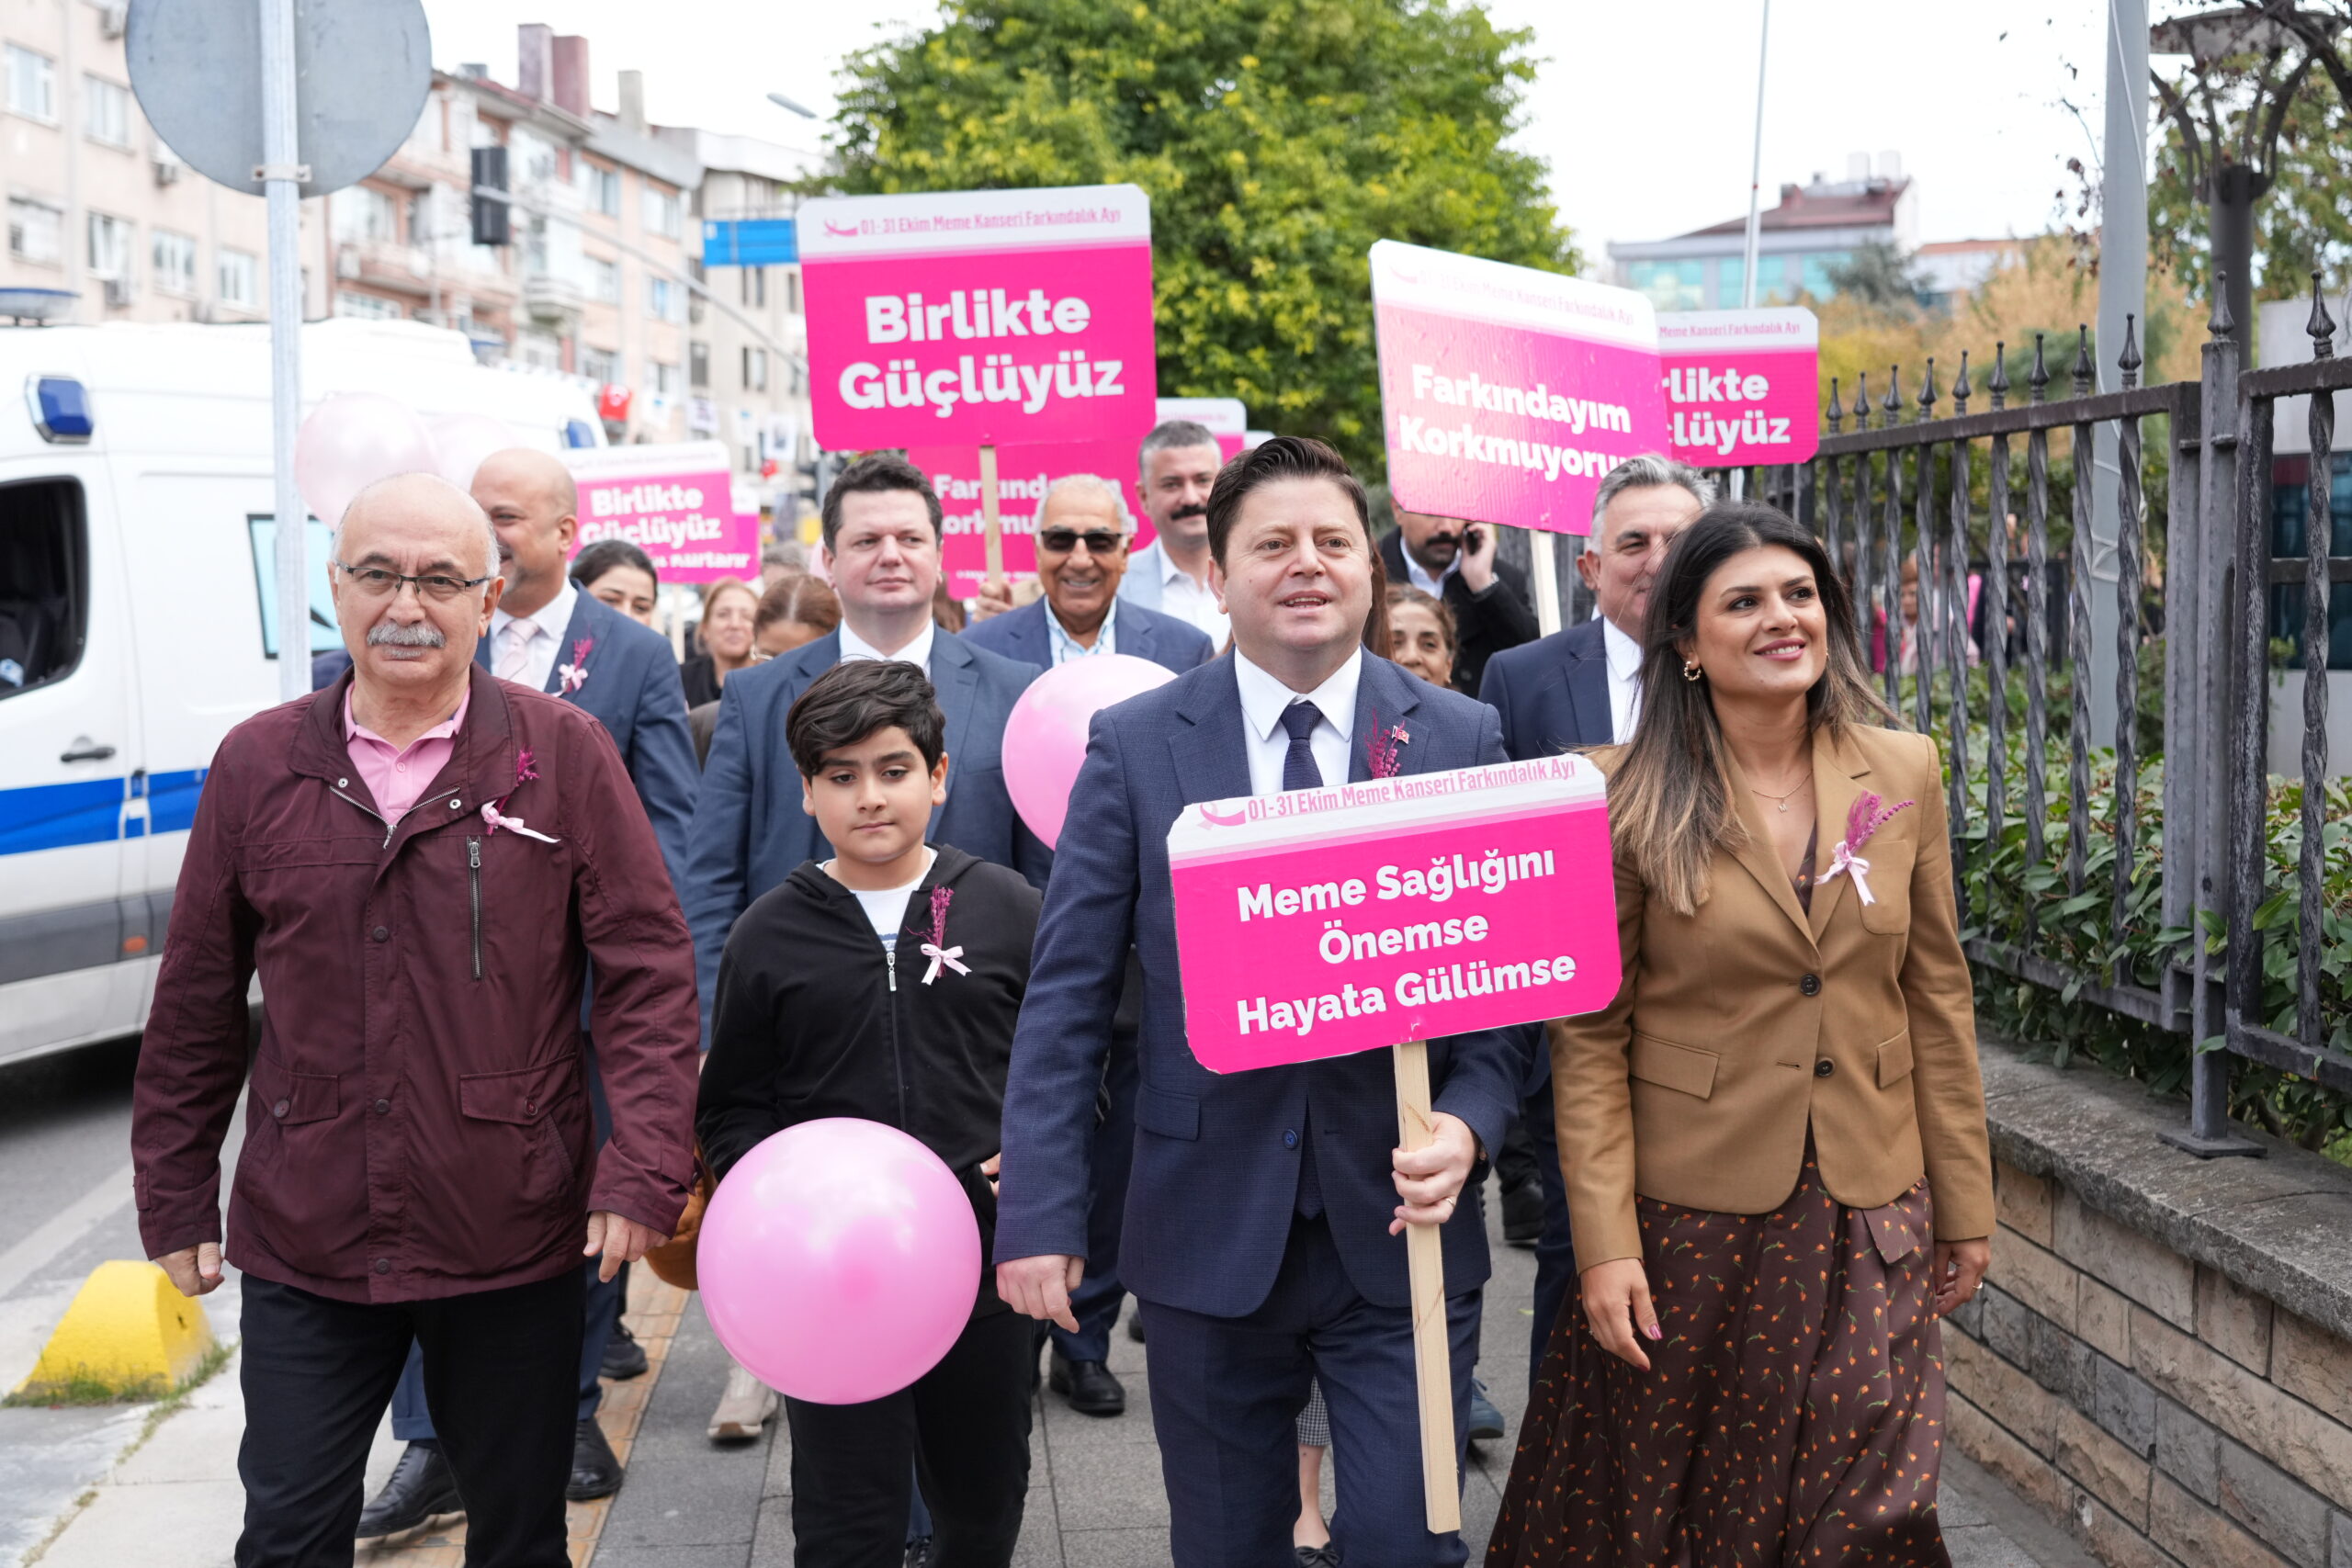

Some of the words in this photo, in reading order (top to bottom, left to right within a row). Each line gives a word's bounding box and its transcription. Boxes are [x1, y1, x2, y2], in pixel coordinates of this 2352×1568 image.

[899, 217, 930, 233] Ekim
[933, 215, 971, 231] Meme
[974, 212, 1022, 229] Kanseri
[1024, 209, 1097, 226] Farkındalık
[1101, 207, 1121, 224] Ayı
[865, 288, 1091, 344] Birlikte
[1516, 288, 1557, 310] Kanseri
[1659, 325, 1688, 338] Meme
[1690, 324, 1726, 337] Kanseri
[1728, 323, 1782, 336] Farkındalık
[1785, 322, 1801, 334] Ayı
[839, 350, 1125, 418] Güçlüyüz
[1412, 365, 1631, 435] Farkındayım
[1398, 415, 1626, 481] Korkmuyoru
[1667, 410, 1791, 455] lüyüz
[590, 484, 704, 517] Birlikte
[1248, 795, 1294, 820] 01-31
[1297, 791, 1339, 814] Ekim
[1341, 784, 1390, 807] Meme
[1394, 773, 1455, 801] Kanseri
[1457, 761, 1547, 792] Farkındalık
[1551, 758, 1576, 780] Ayı
[1237, 878, 1367, 922] Meme
[1375, 849, 1555, 903] Sağlığını
[1318, 915, 1489, 964] Önemse
[1237, 983, 1387, 1036] Hayata
[1394, 955, 1577, 1008] Gülümse
